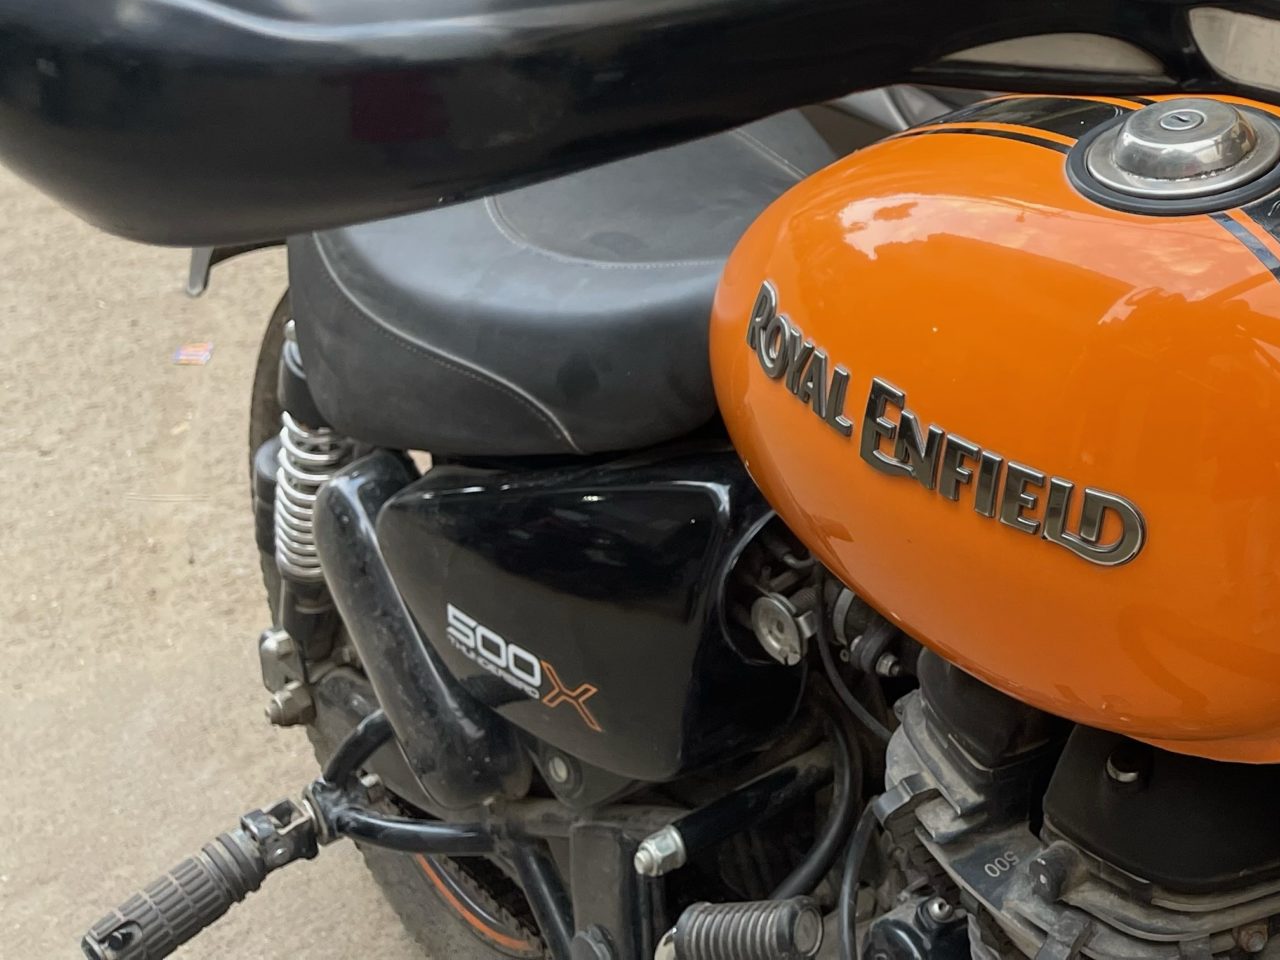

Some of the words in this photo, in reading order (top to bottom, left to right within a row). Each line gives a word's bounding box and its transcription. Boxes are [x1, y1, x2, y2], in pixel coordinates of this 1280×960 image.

[746, 280, 853, 438] ROYAL
[860, 377, 1146, 566] ENFIELD
[984, 851, 1020, 877] 500
